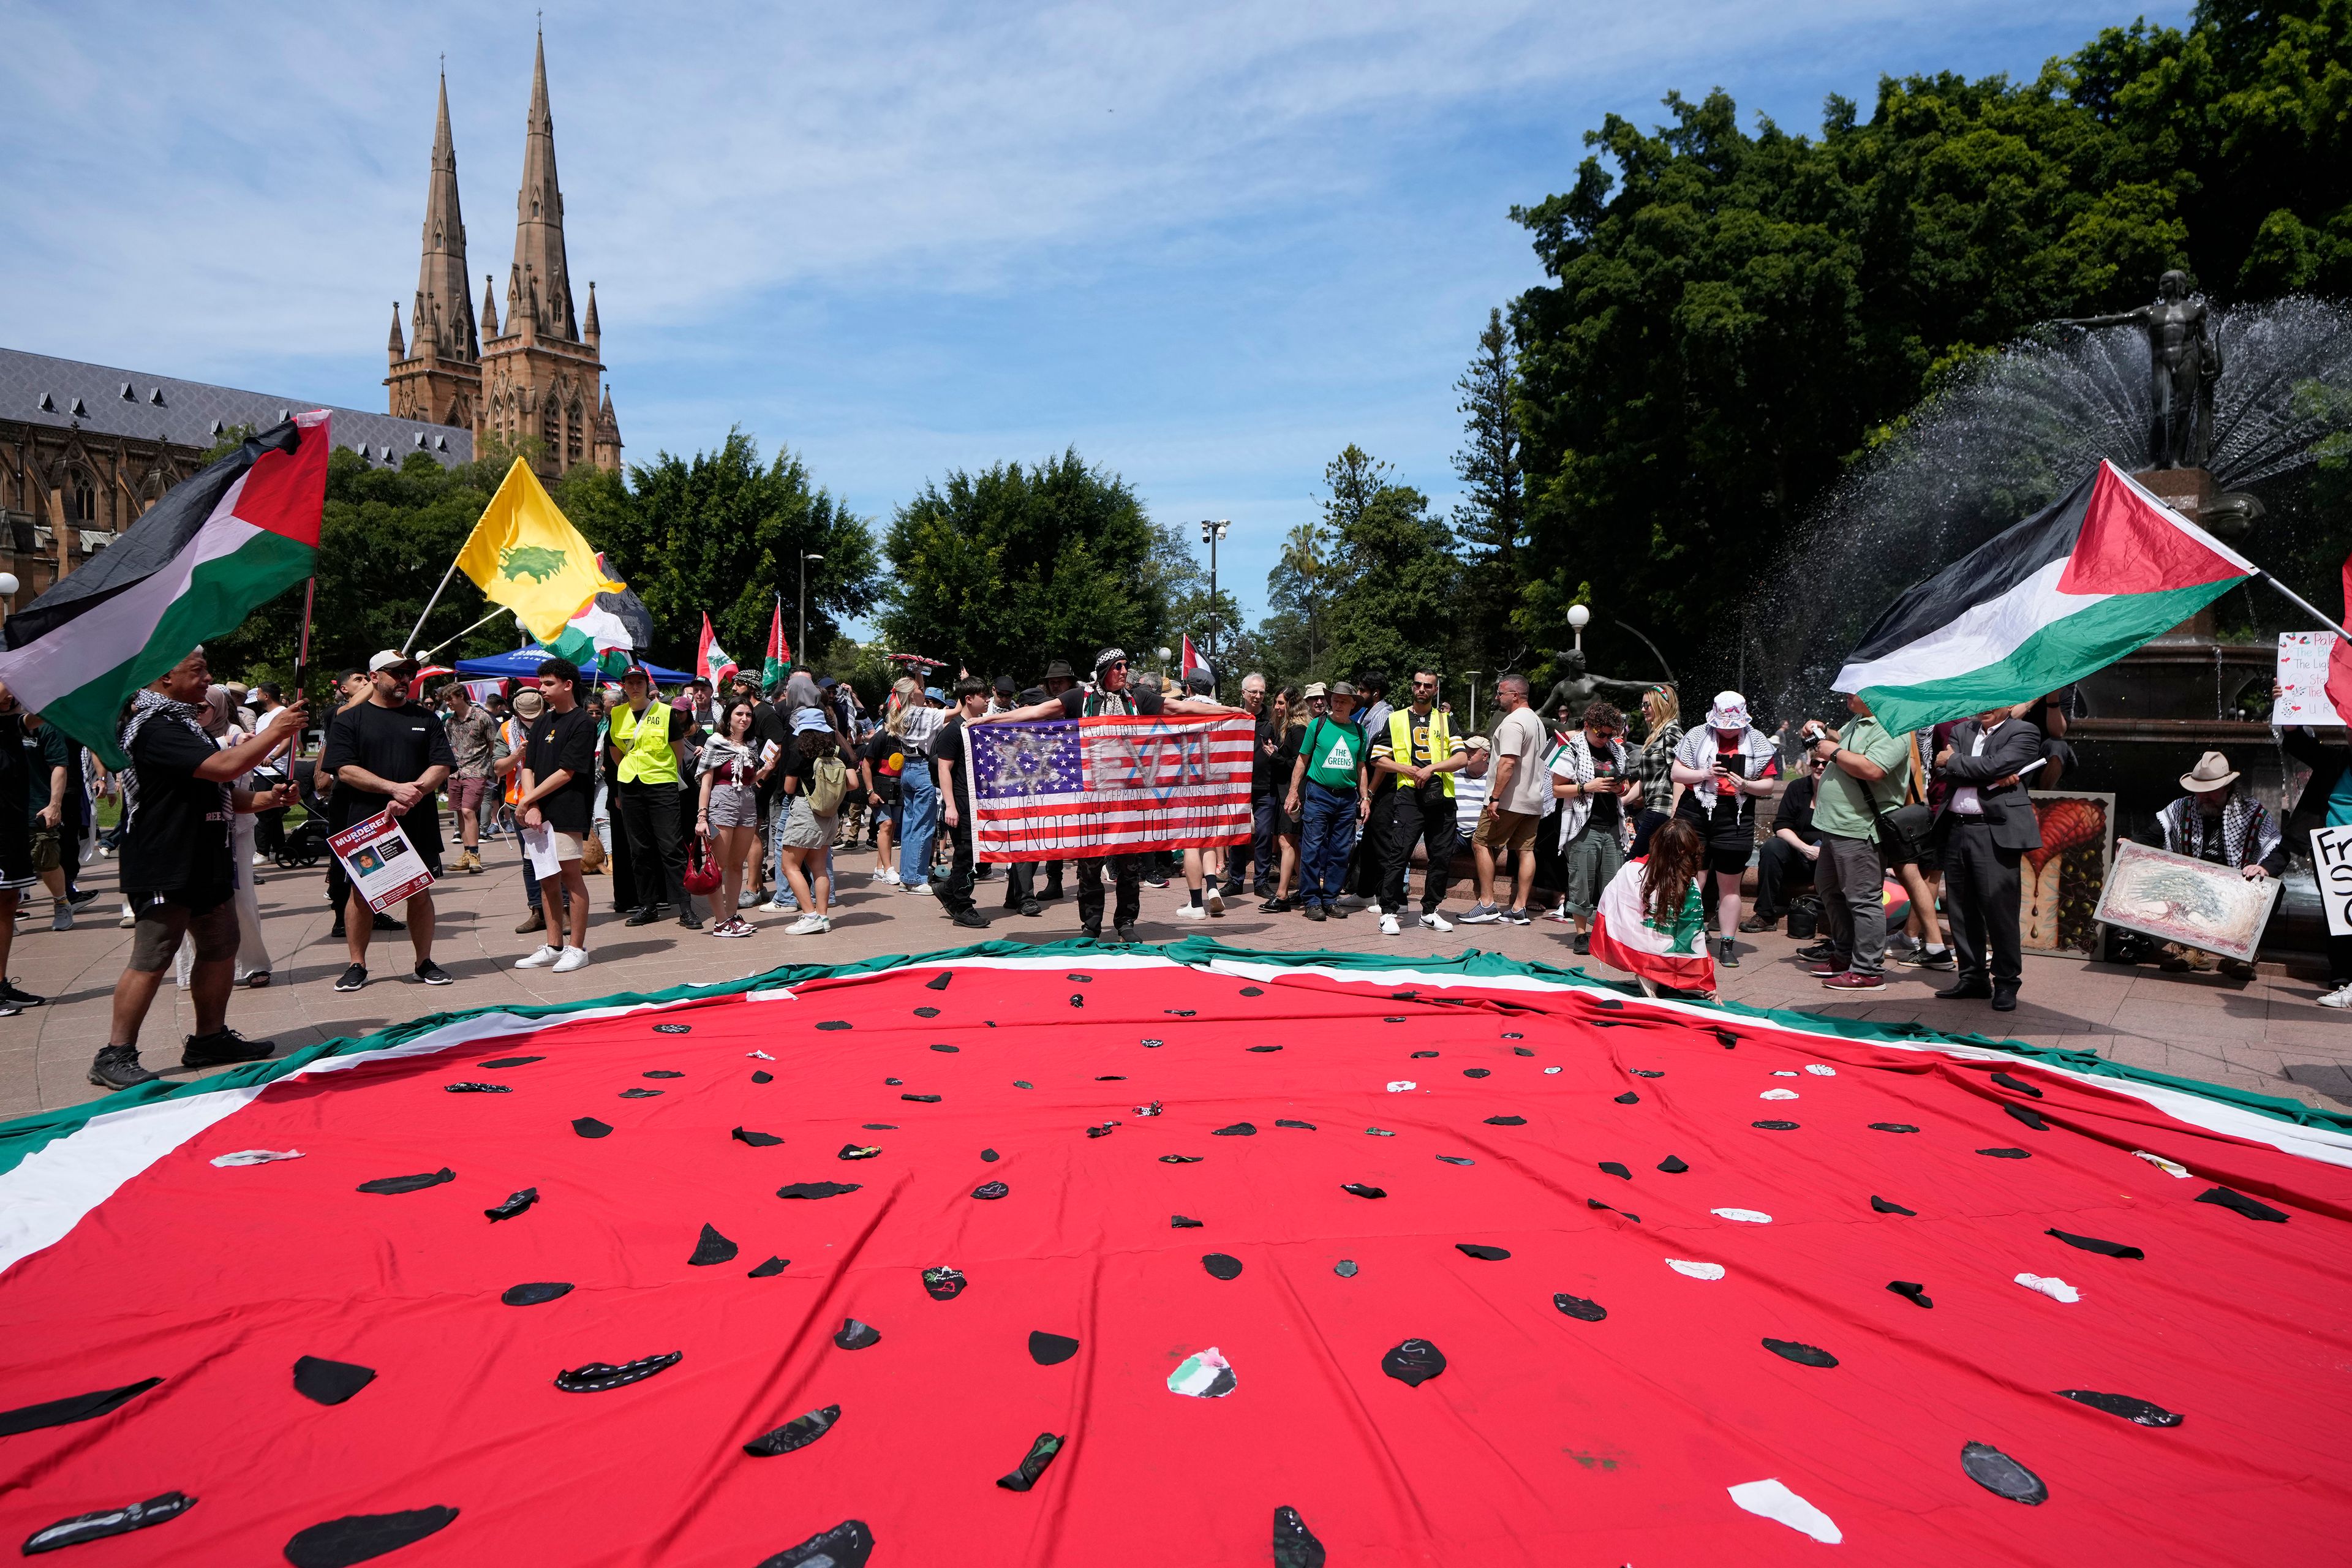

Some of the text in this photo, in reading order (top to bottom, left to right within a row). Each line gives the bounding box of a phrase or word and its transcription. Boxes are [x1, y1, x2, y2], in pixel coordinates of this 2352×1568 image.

[2293, 647, 2312, 657] The
[2293, 658, 2310, 669] The
[2303, 685, 2322, 697] The
[647, 716, 660, 725] PAG
[1082, 724, 1138, 738] EVOLUTION
[1178, 724, 1189, 733] OF
[1335, 748, 1347, 757] THE
[1089, 733, 1231, 790] EVIL
[1328, 757, 1351, 766] GREENS
[977, 783, 1242, 810] FASCIST ITALY NAZI GERMANY ZIONIST ISRAEL
[983, 803, 1237, 853] GENOCIDE JOE BIDEN
[361, 830, 377, 840] ISRAEL
[768, 1424, 829, 1451] PALESTINE
